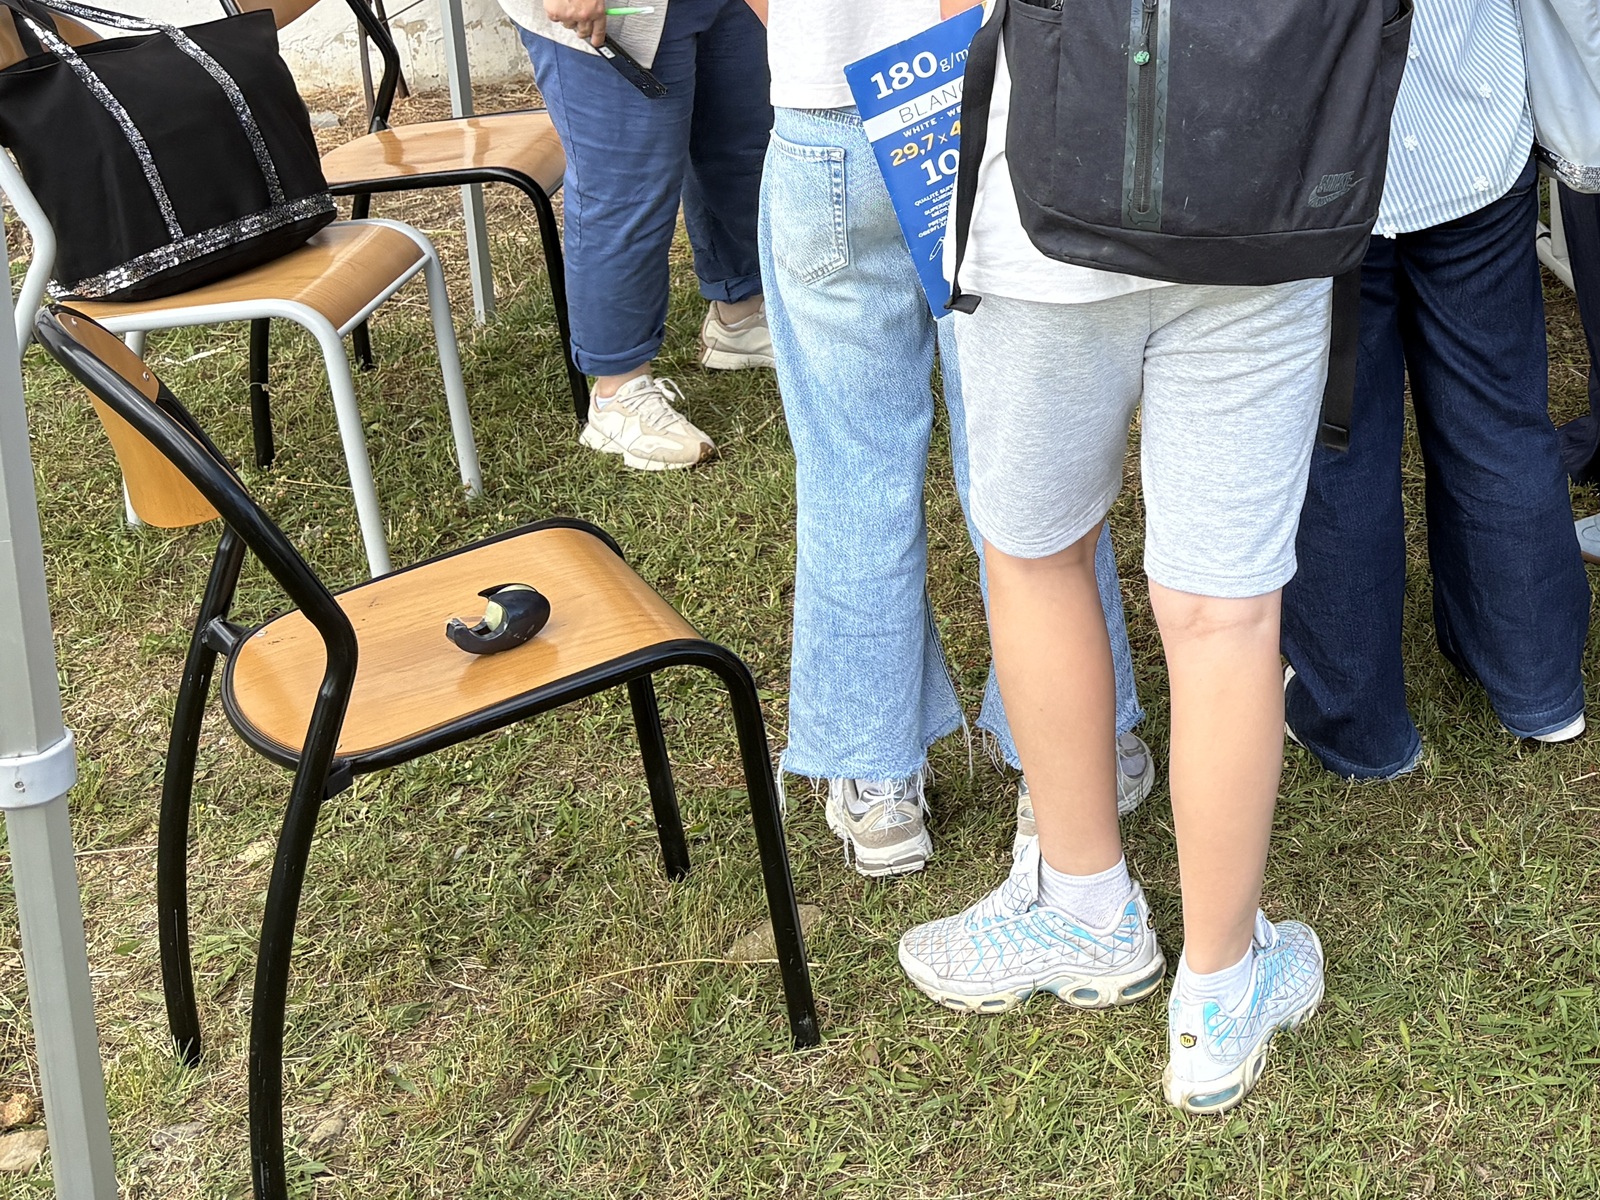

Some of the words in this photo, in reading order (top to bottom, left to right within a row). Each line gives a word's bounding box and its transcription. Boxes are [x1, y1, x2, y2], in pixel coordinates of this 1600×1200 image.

[870, 51, 938, 100] 180
[939, 42, 971, 73] g/m
[903, 117, 937, 138] WHITE
[890, 132, 934, 167] 29,7
[920, 148, 960, 186] 10
